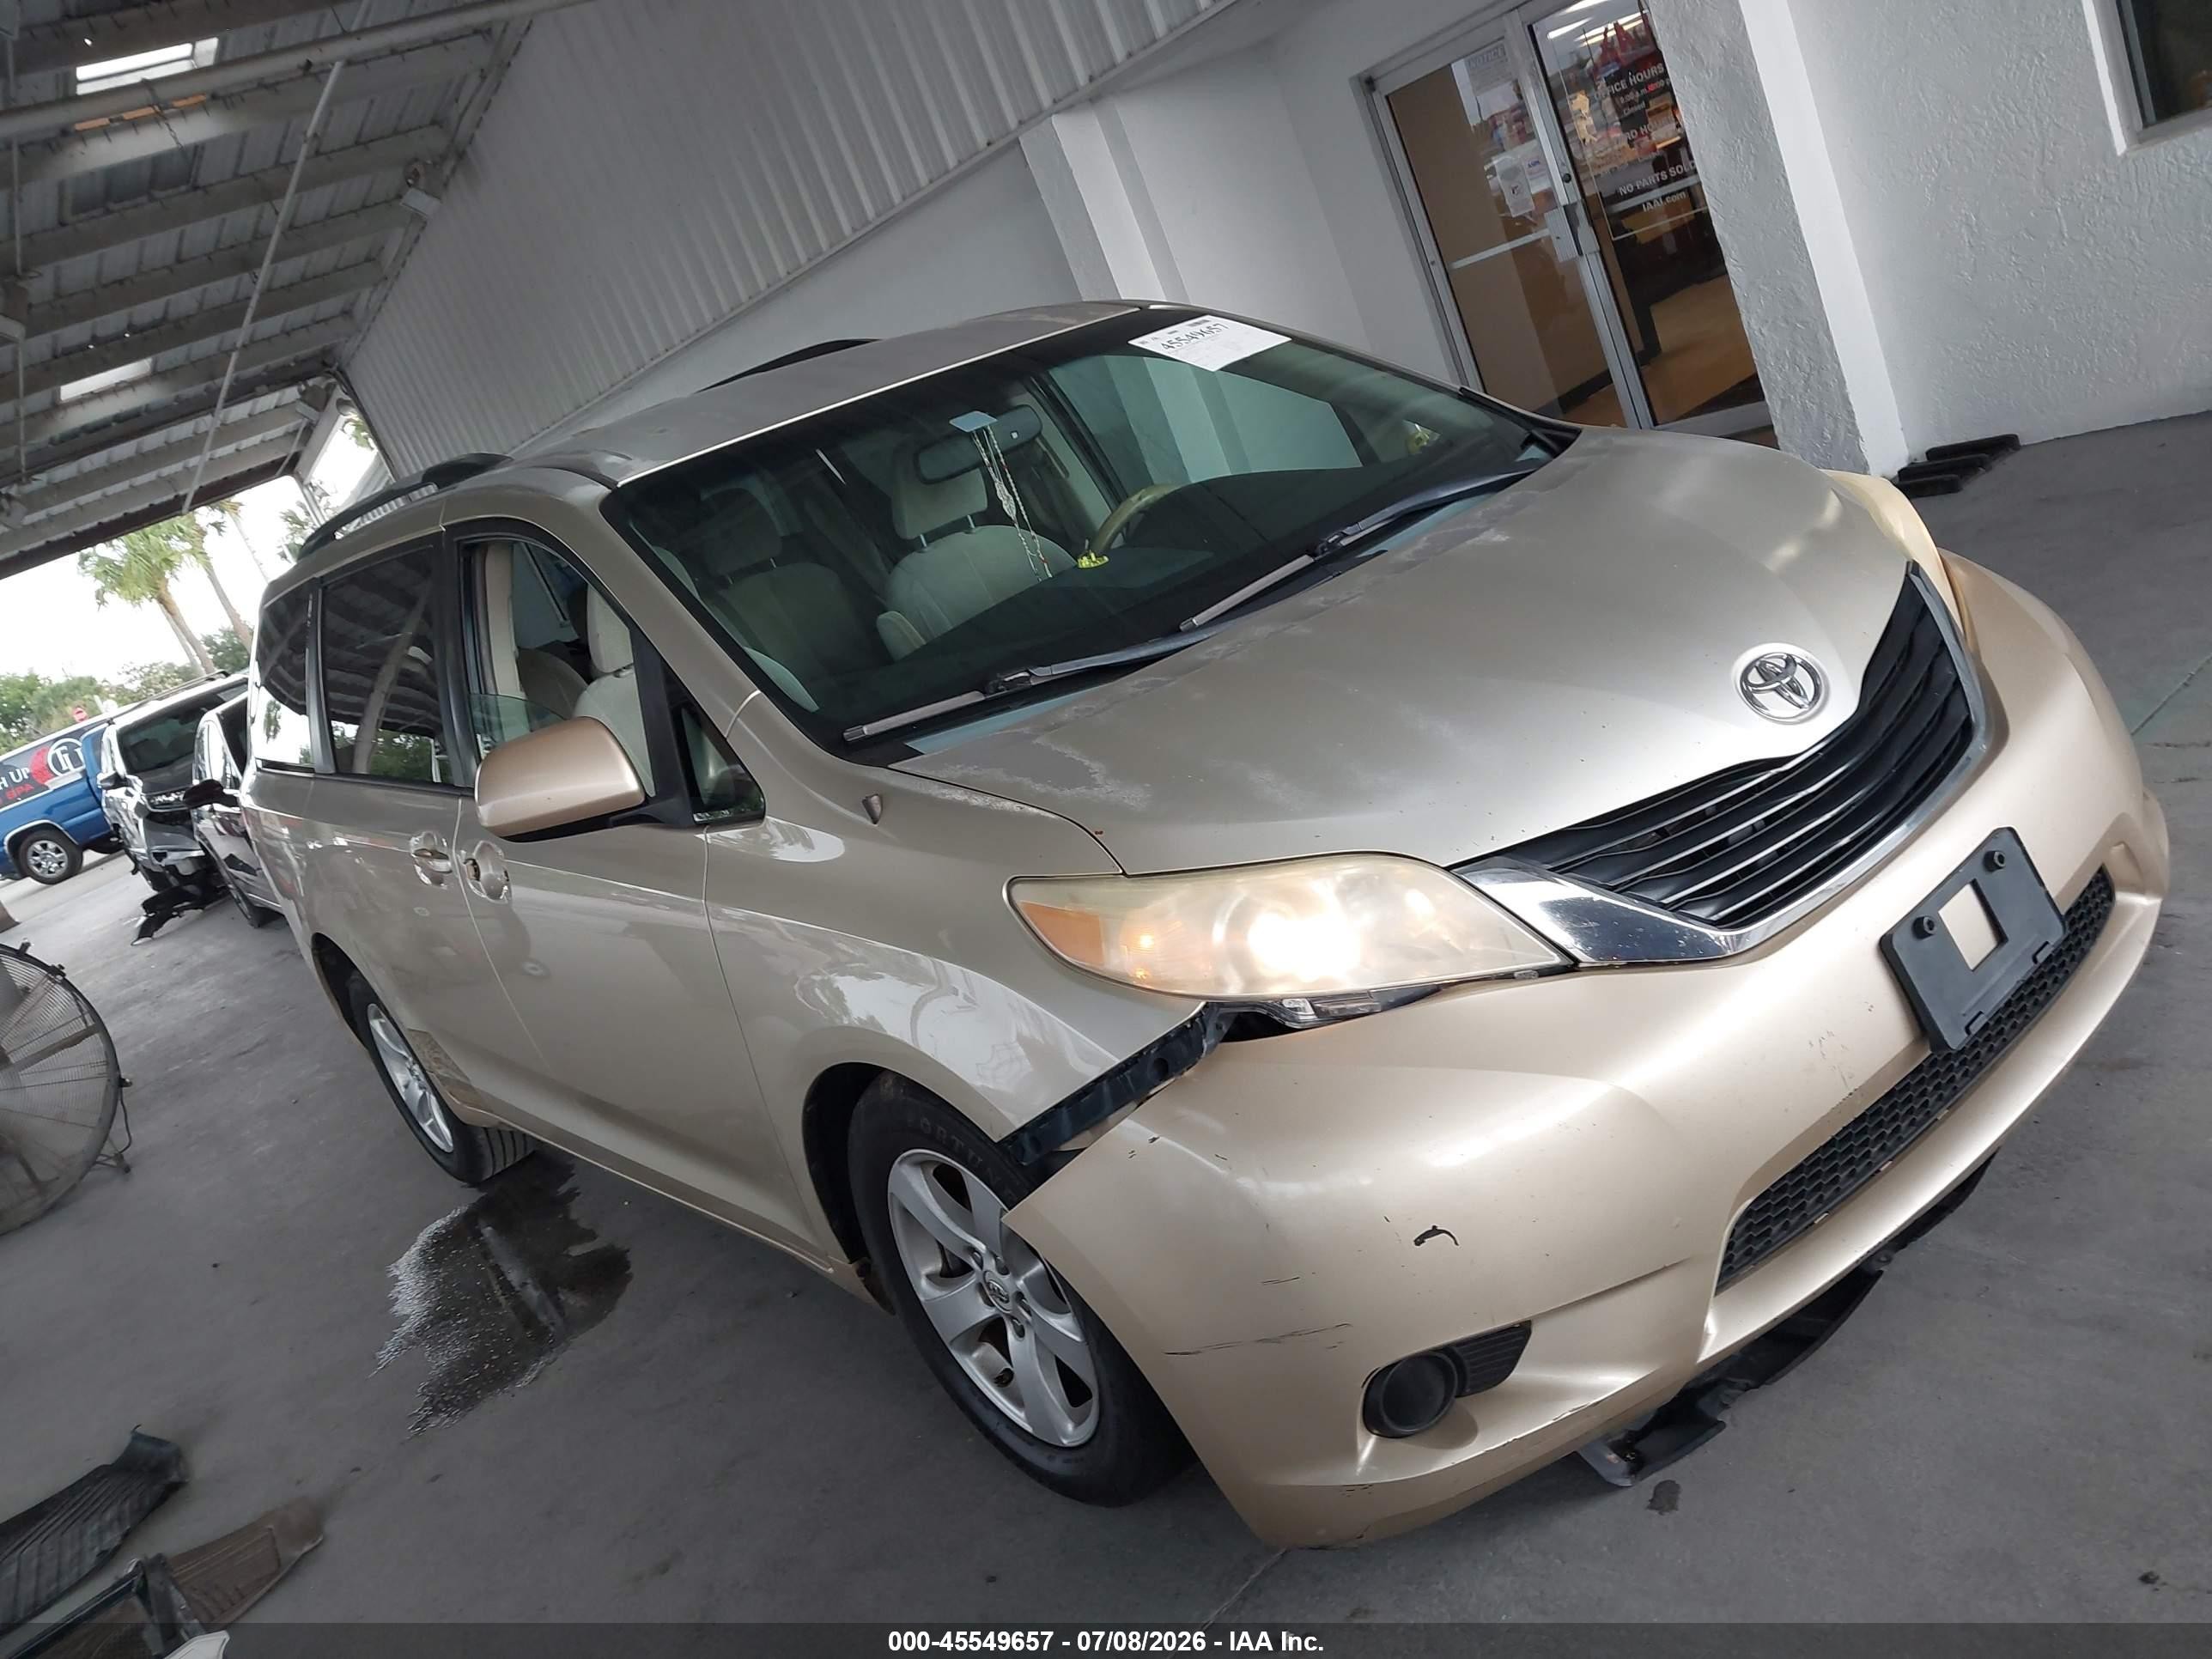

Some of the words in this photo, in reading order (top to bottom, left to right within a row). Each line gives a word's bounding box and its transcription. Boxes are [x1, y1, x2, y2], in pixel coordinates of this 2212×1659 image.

[1629, 63, 1664, 86] HOURS
[1619, 184, 1634, 196] NO
[1636, 170, 1668, 189] PARTS
[1642, 191, 1686, 213] IAAI.com
[1161, 323, 1230, 349] 45549657
